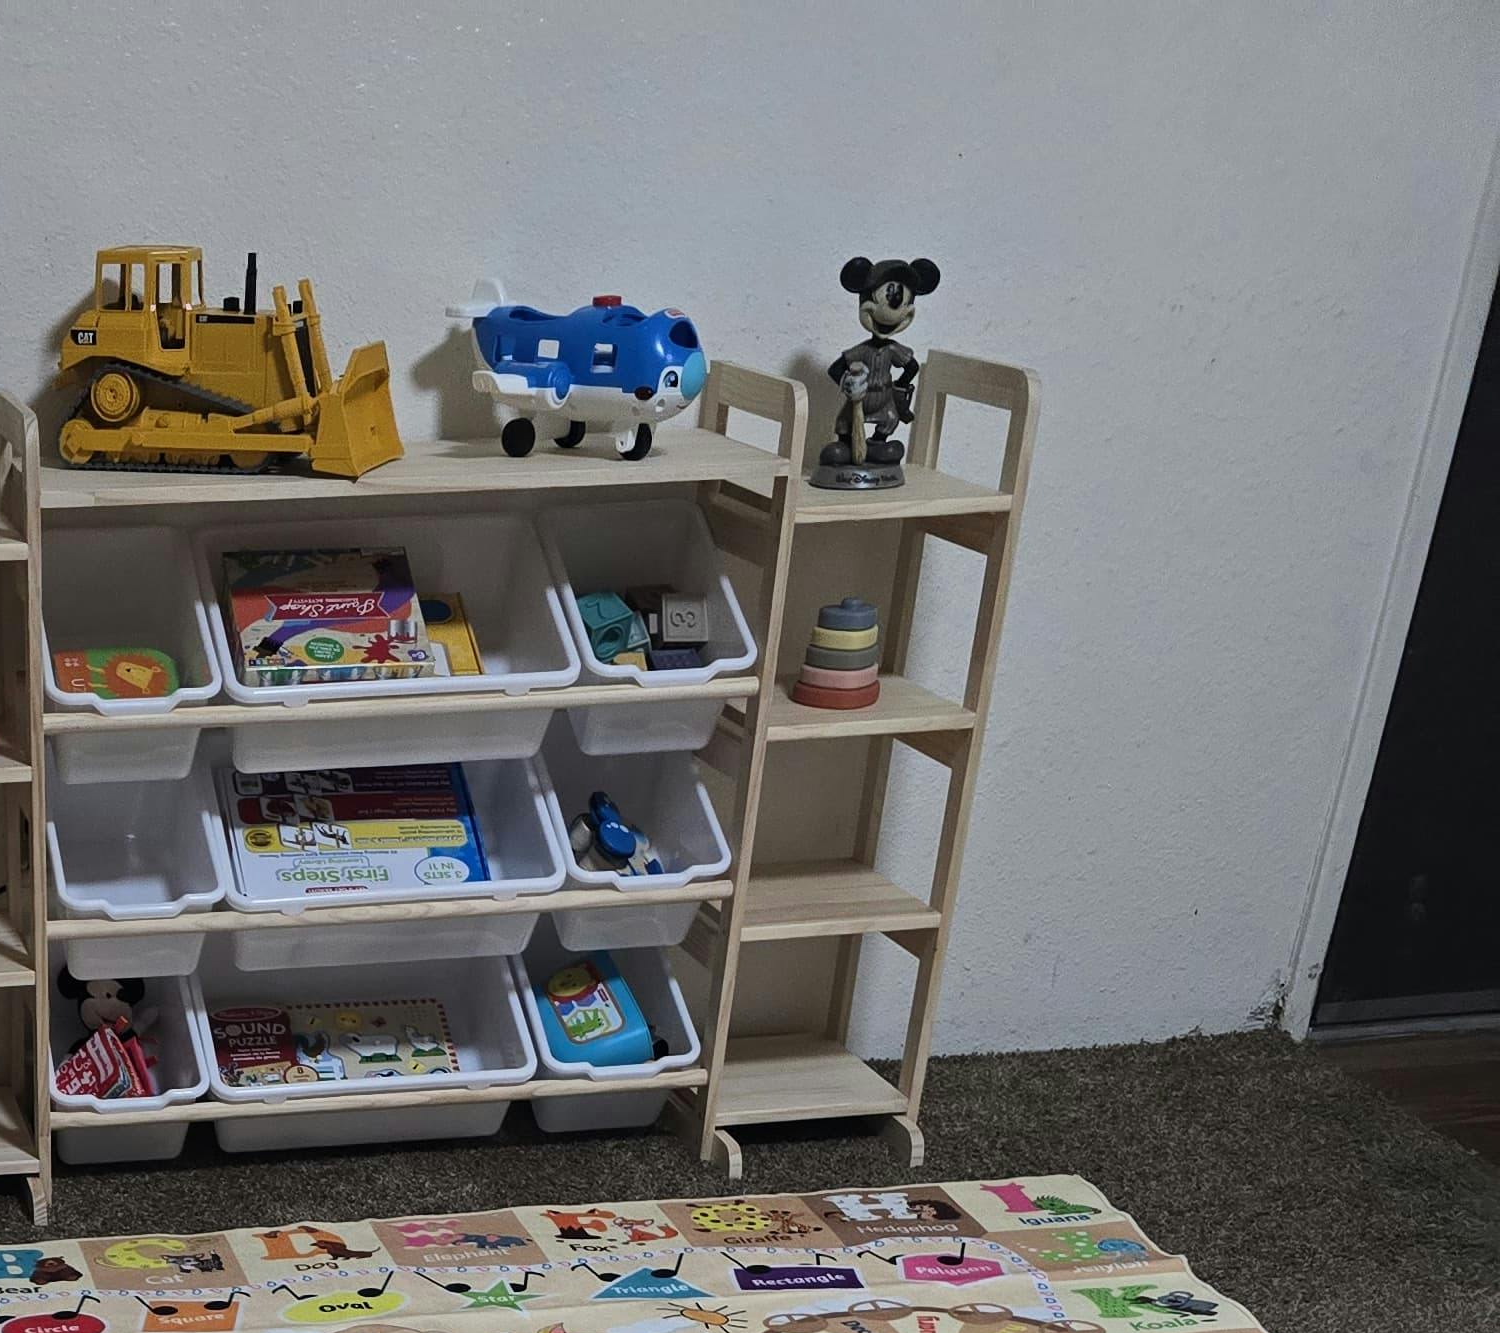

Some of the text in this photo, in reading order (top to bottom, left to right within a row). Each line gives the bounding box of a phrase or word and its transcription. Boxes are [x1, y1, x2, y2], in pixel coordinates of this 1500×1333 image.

[77, 331, 94, 344] CAT
[278, 593, 375, 617] Paint Shop
[279, 865, 390, 882] First Steps
[214, 1022, 286, 1040] SOUND
[229, 1035, 277, 1047] PUZZLE
[822, 1193, 919, 1221] H
[1019, 1214, 1091, 1226] Iguana
[857, 1221, 959, 1235] Hedgehog
[252, 1226, 348, 1261] D
[723, 1233, 793, 1245] Giraffe
[104, 1238, 187, 1269] C
[422, 1246, 510, 1264] Elephant
[568, 1243, 611, 1253] Fox
[294, 1260, 340, 1272] Dog
[915, 1262, 992, 1278] Polygon
[1072, 1260, 1150, 1274] Jellyfish
[144, 1274, 184, 1286] Cat
[752, 1271, 846, 1286] Rectangle
[610, 1280, 691, 1297] Triangle
[478, 1294, 516, 1304] Star
[317, 1301, 373, 1313] Oval
[158, 1312, 226, 1326] Square
[1129, 1317, 1199, 1331] Koala
